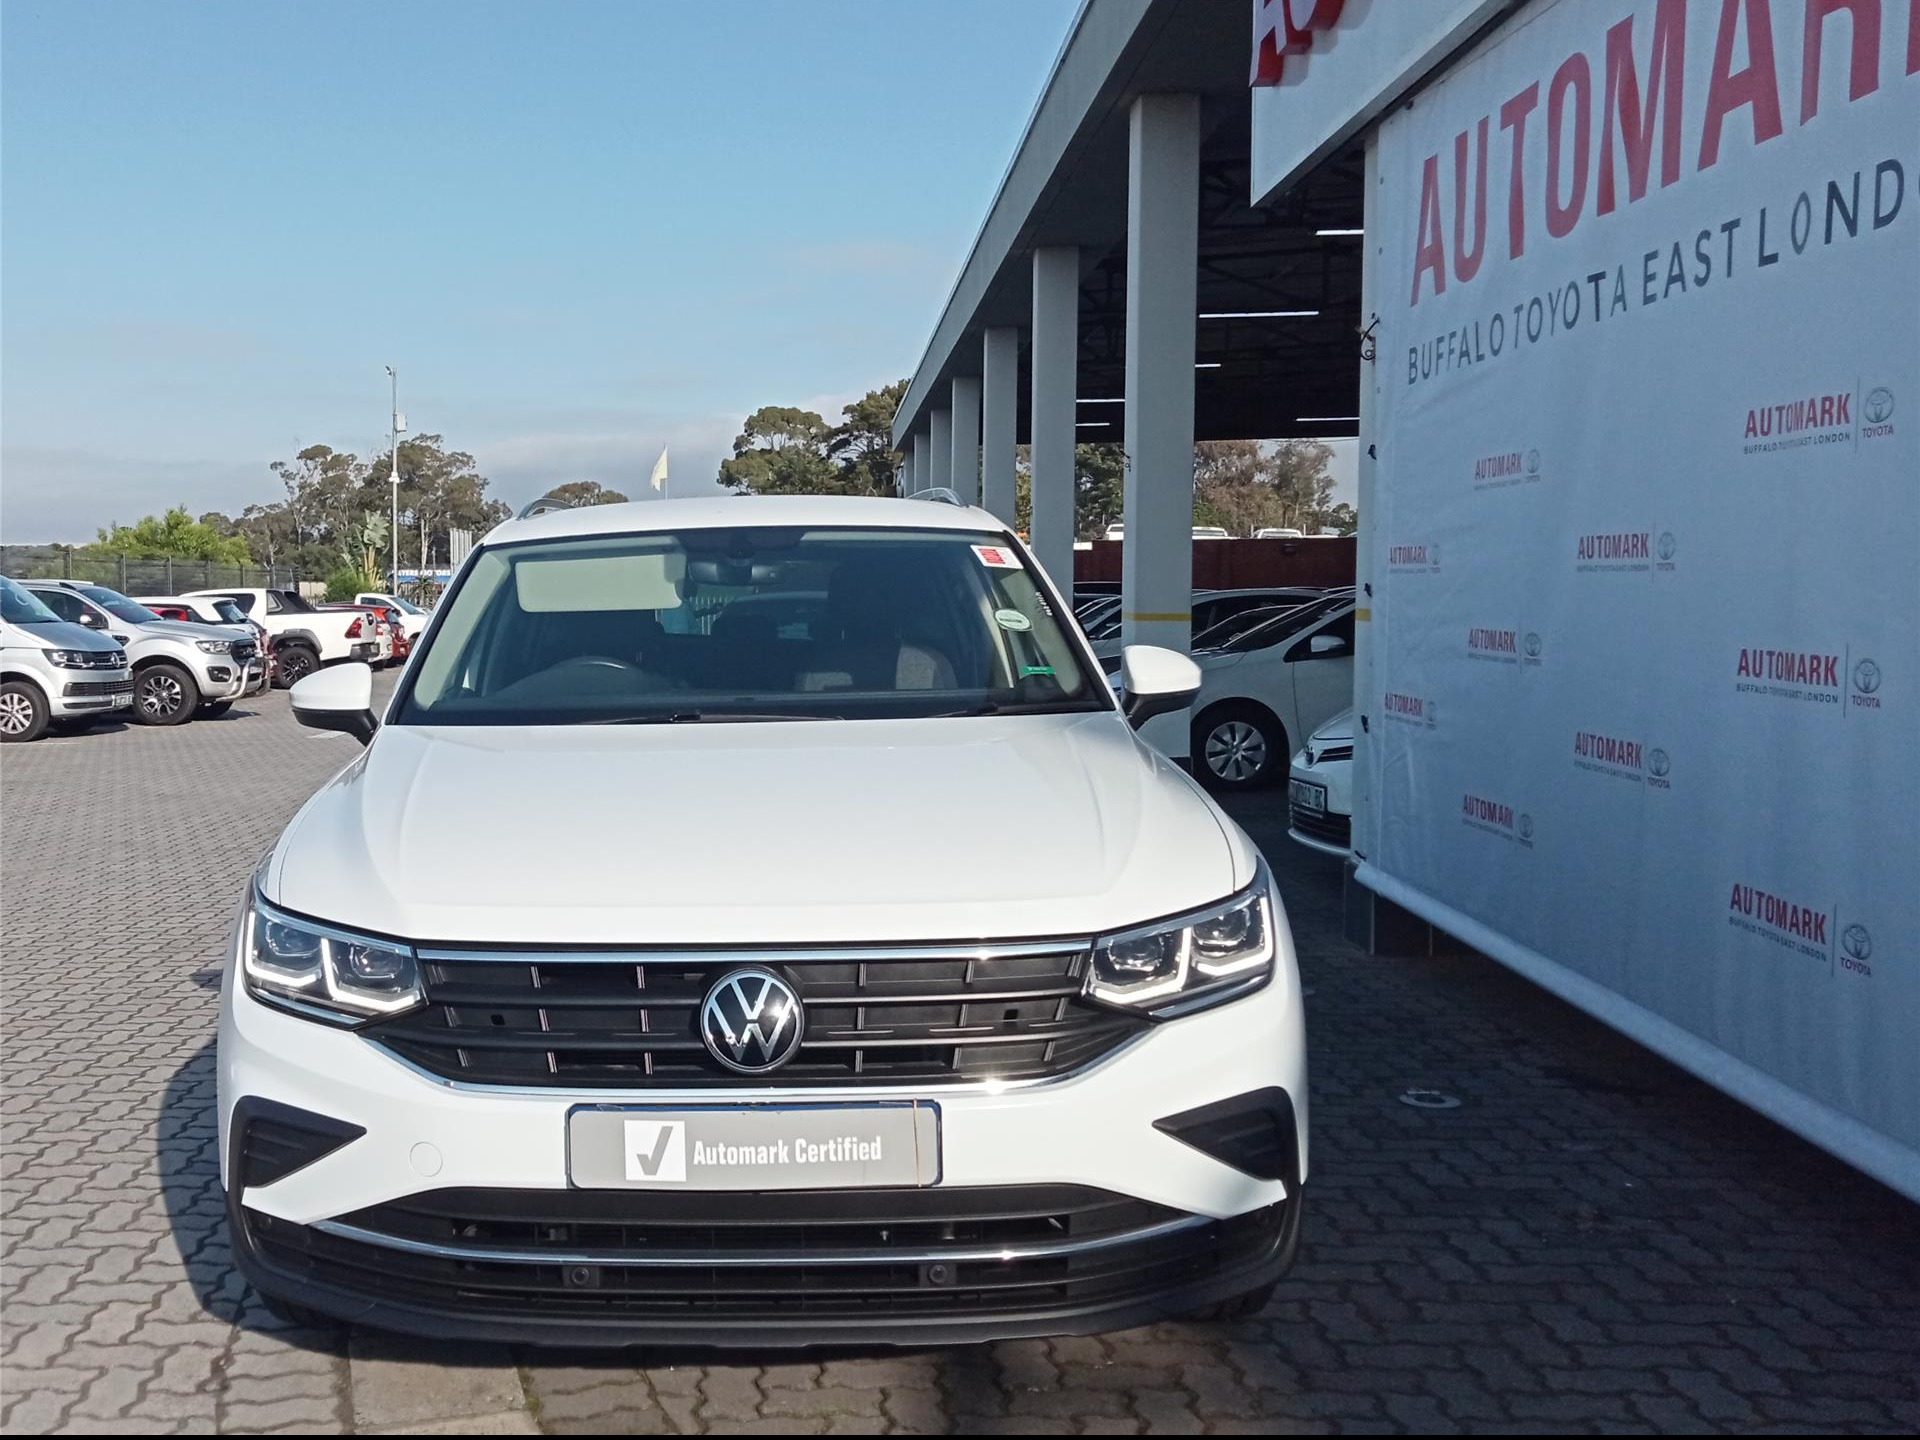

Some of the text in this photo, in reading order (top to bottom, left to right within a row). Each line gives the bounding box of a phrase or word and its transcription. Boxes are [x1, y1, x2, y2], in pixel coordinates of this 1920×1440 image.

[1410, 0, 1920, 306] AUTOMA
[1409, 159, 1920, 384] BUFFALO TOYOTA EAST LOND
[1745, 393, 1851, 438] AUTOMARK
[1814, 432, 1850, 444] LONDON
[1862, 424, 1894, 438] TOYOTA
[1578, 533, 1649, 559] AUTOMARK
[1737, 648, 1839, 687] AUTOMARK
[1803, 692, 1838, 703] LONDON
[1852, 695, 1881, 708] TOYOTA
[1575, 732, 1642, 769] AUTOMARK
[1730, 884, 1827, 945] AUTOMARK
[1840, 957, 1872, 977] TOYOTA
[693, 1135, 882, 1165] Automark Certified
